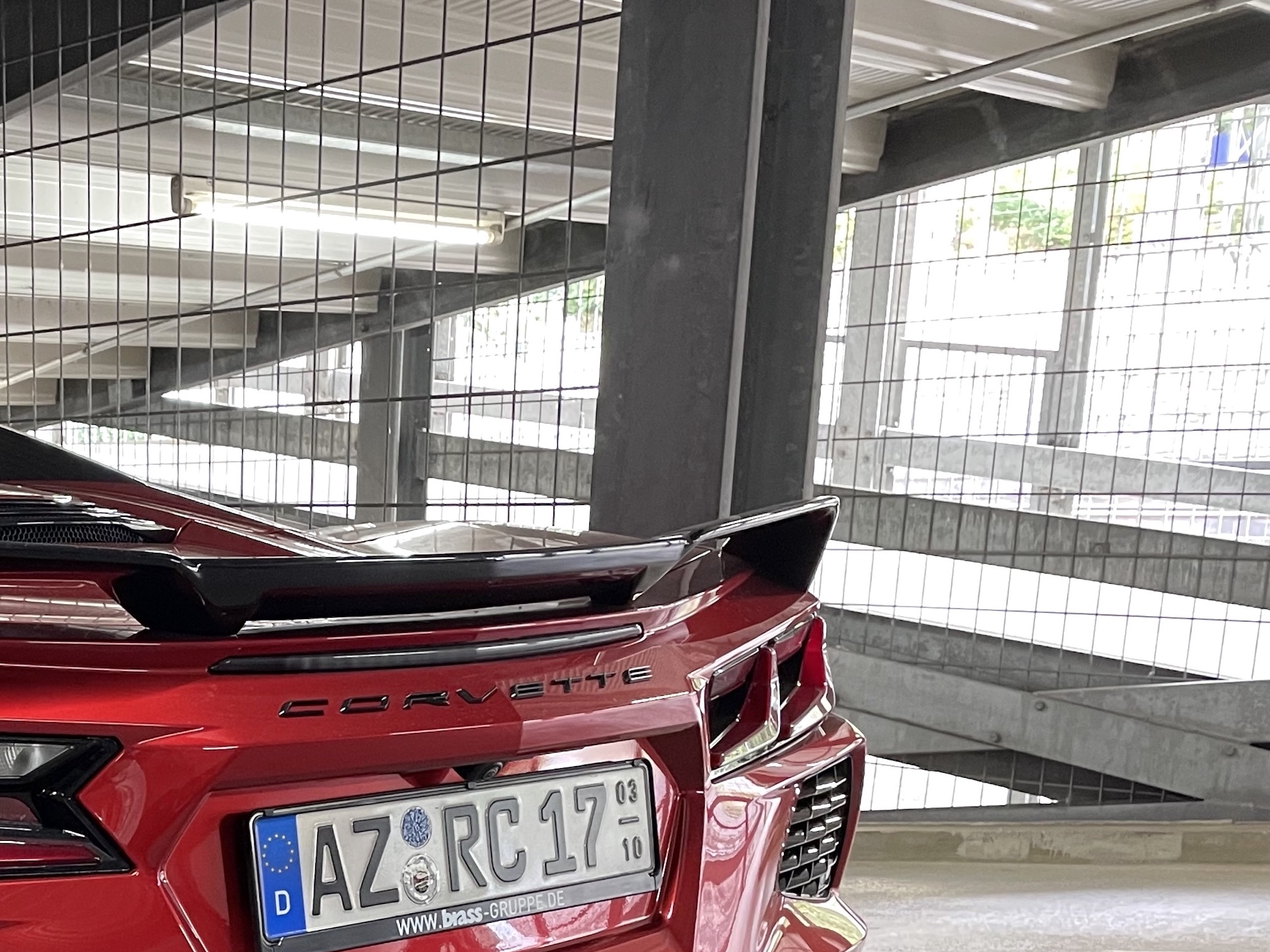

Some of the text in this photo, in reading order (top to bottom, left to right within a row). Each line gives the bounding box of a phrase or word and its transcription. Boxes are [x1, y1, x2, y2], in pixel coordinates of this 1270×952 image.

[278, 665, 653, 718] CORVETTE
[615, 779, 638, 805] 03
[311, 783, 607, 916] AZ RC 17
[621, 836, 643, 861] 10
[274, 890, 291, 916] D
